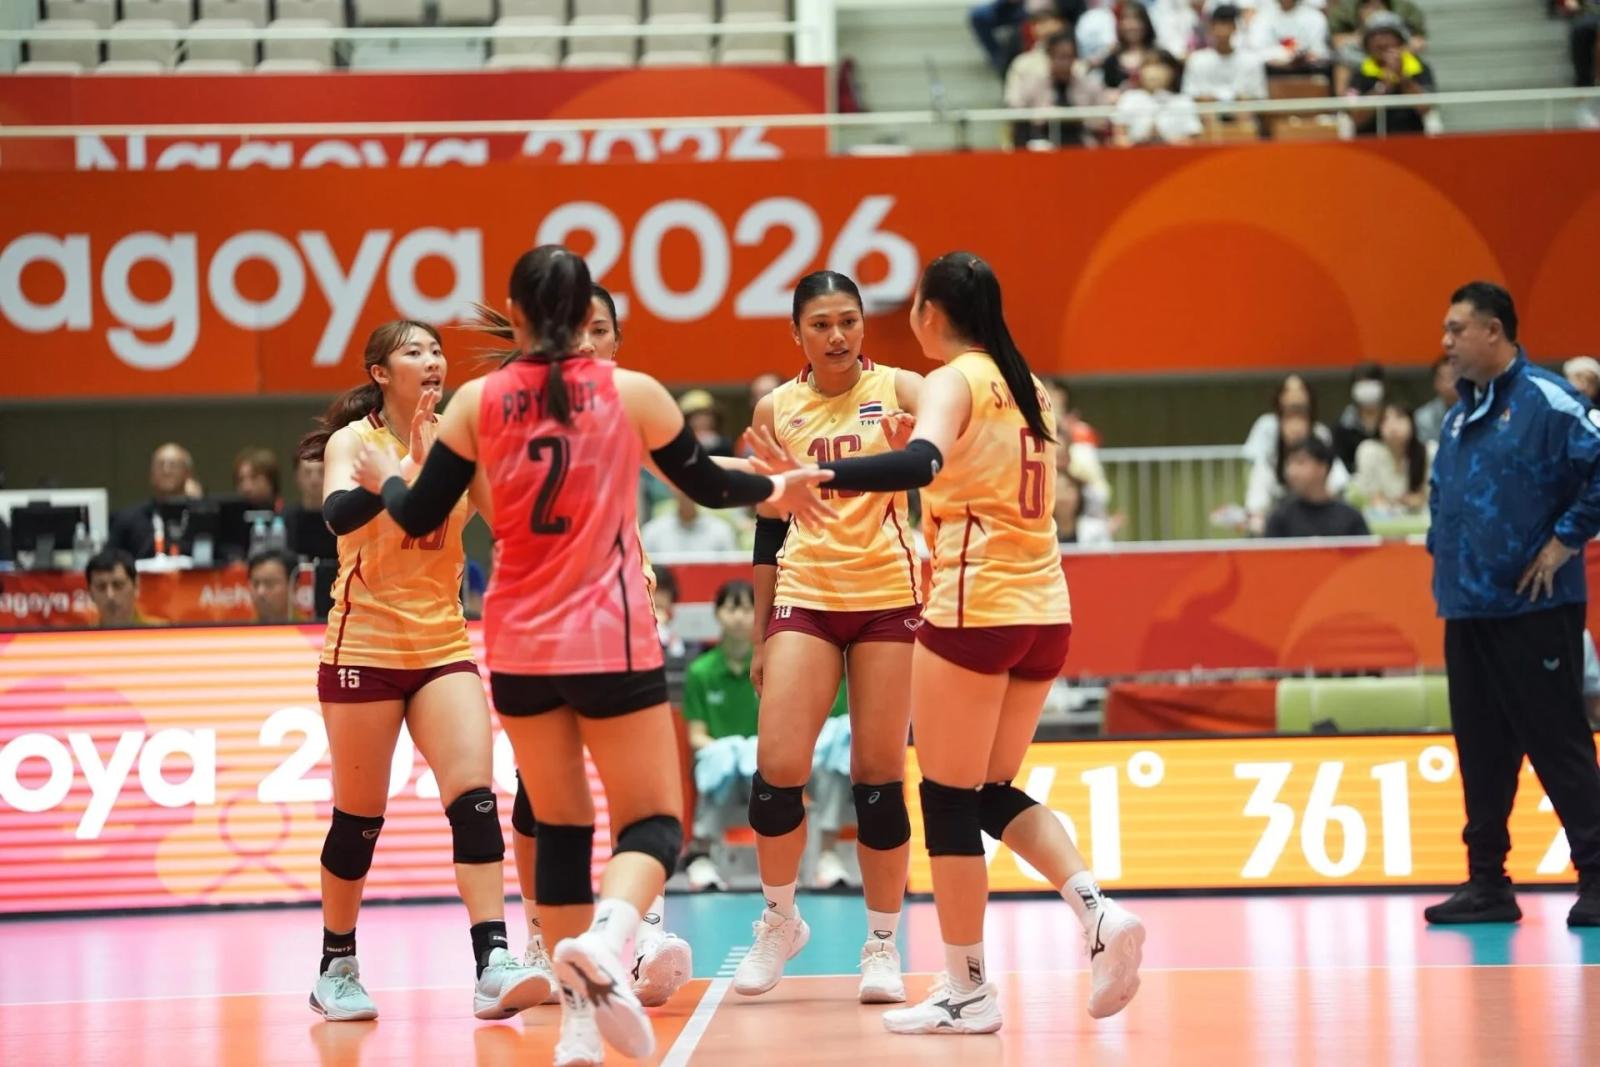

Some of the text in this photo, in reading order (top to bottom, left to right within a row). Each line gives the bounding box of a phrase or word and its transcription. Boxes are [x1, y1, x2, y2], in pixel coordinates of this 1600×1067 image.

[0, 228, 484, 370] agoya
[528, 436, 572, 536] 2
[1019, 427, 1046, 519] 6
[337, 668, 361, 688] 15
